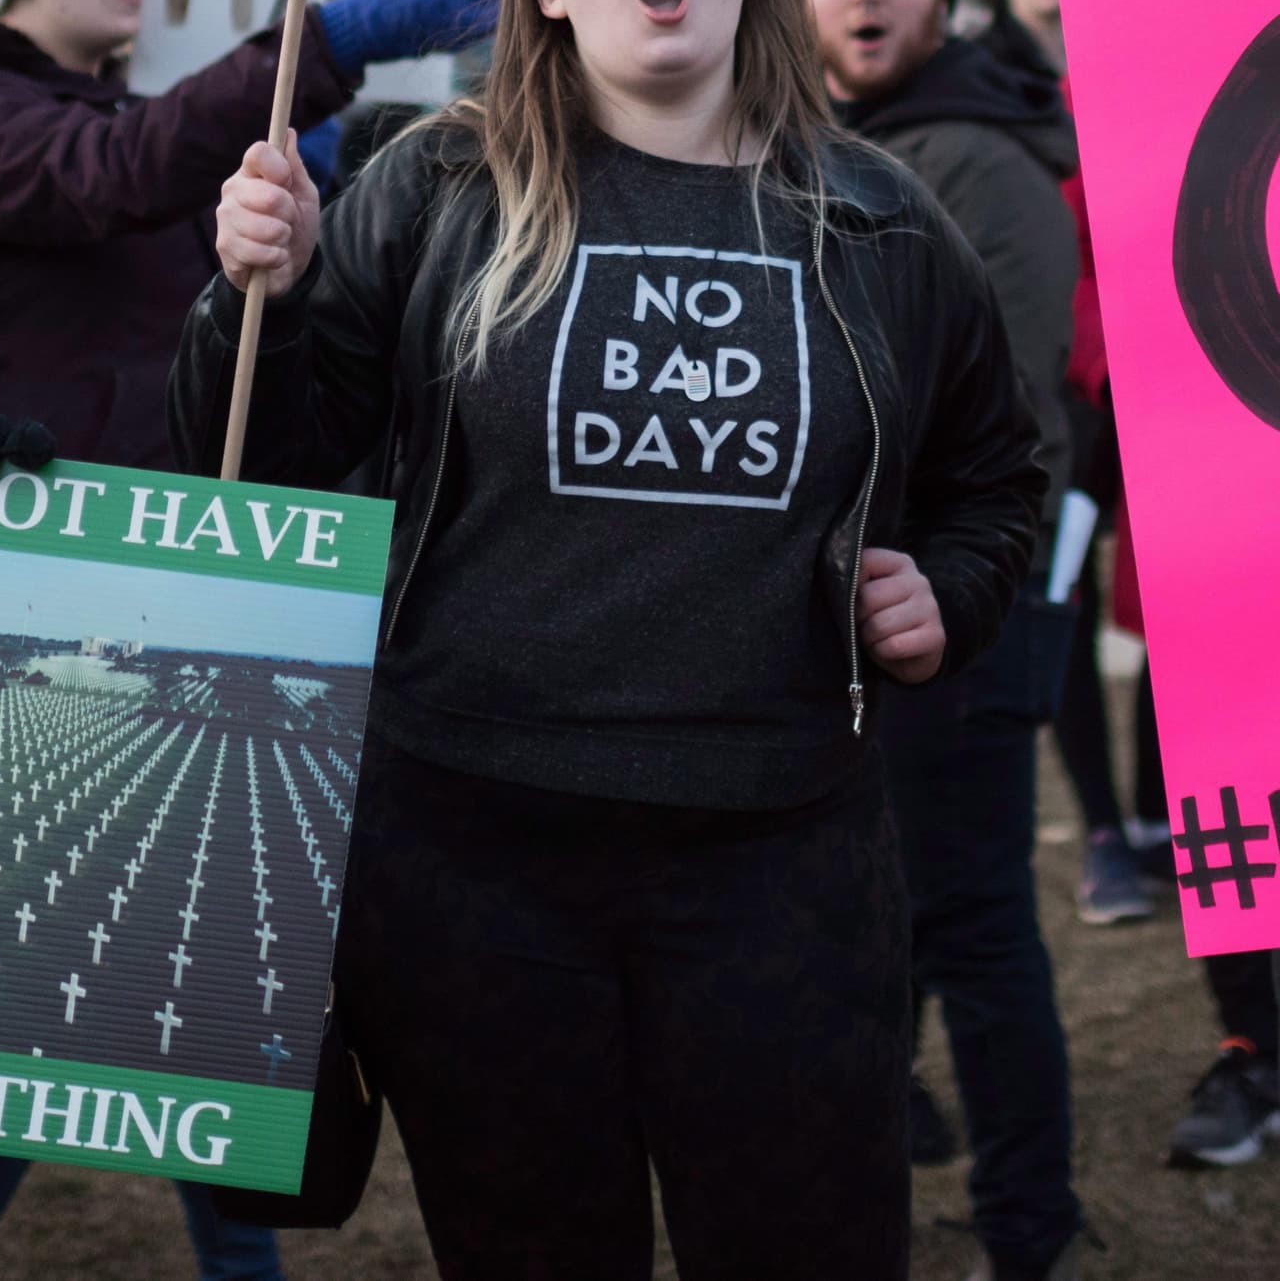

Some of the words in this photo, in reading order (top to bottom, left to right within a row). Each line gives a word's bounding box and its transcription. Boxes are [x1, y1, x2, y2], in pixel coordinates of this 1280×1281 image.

[633, 274, 742, 327] NO
[603, 339, 761, 398] BAD
[574, 412, 780, 476] DAYS
[122, 488, 342, 568] HAVE
